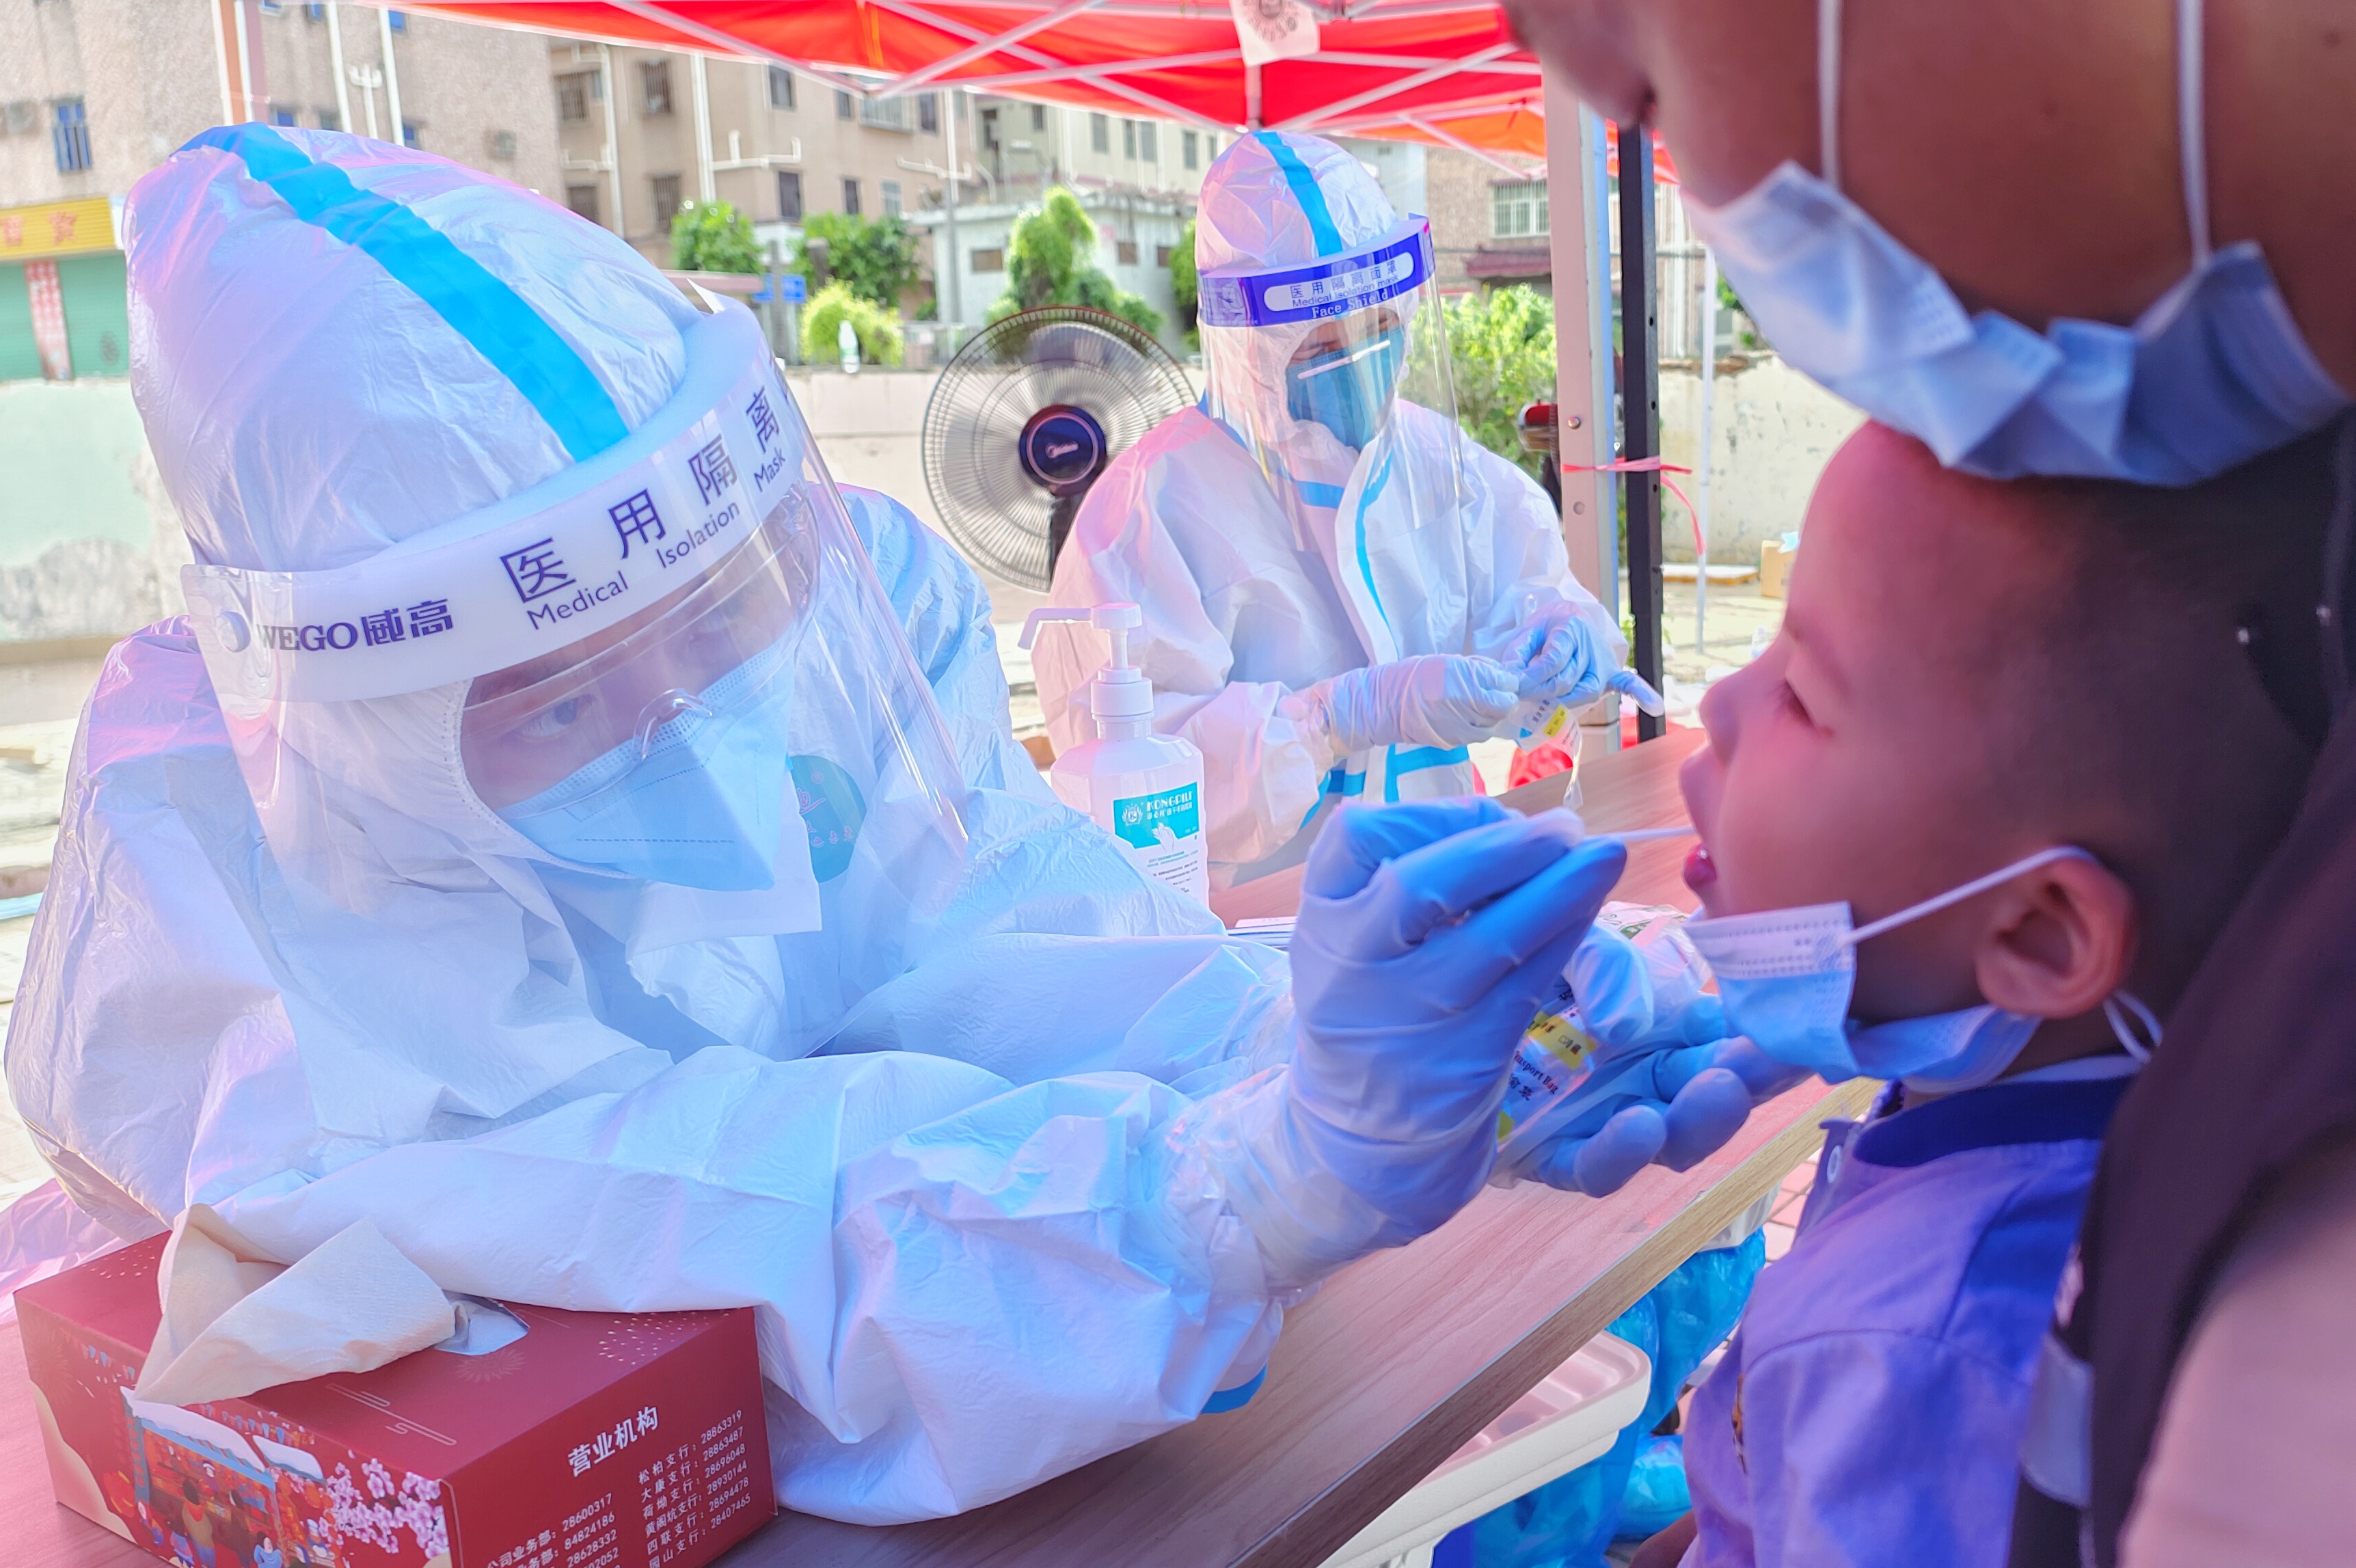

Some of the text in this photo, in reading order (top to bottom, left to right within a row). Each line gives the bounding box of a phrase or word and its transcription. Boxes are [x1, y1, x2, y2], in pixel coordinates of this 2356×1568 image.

[1292, 292, 1331, 307] Medical
[1311, 287, 1389, 319] Face Shield
[526, 447, 786, 630] Medical Isolation Mask
[567, 1405, 660, 1477] 营业机构
[701, 1409, 742, 1444] 28863319
[703, 1426, 744, 1461] 28863487
[705, 1443, 746, 1478] 28696048
[707, 1459, 747, 1495] 28930144
[562, 1492, 612, 1532] 28600317
[709, 1476, 749, 1513] 28694478
[711, 1493, 751, 1529] 28407465
[564, 1511, 615, 1550] 84824186
[566, 1528, 617, 1568] 28628332
